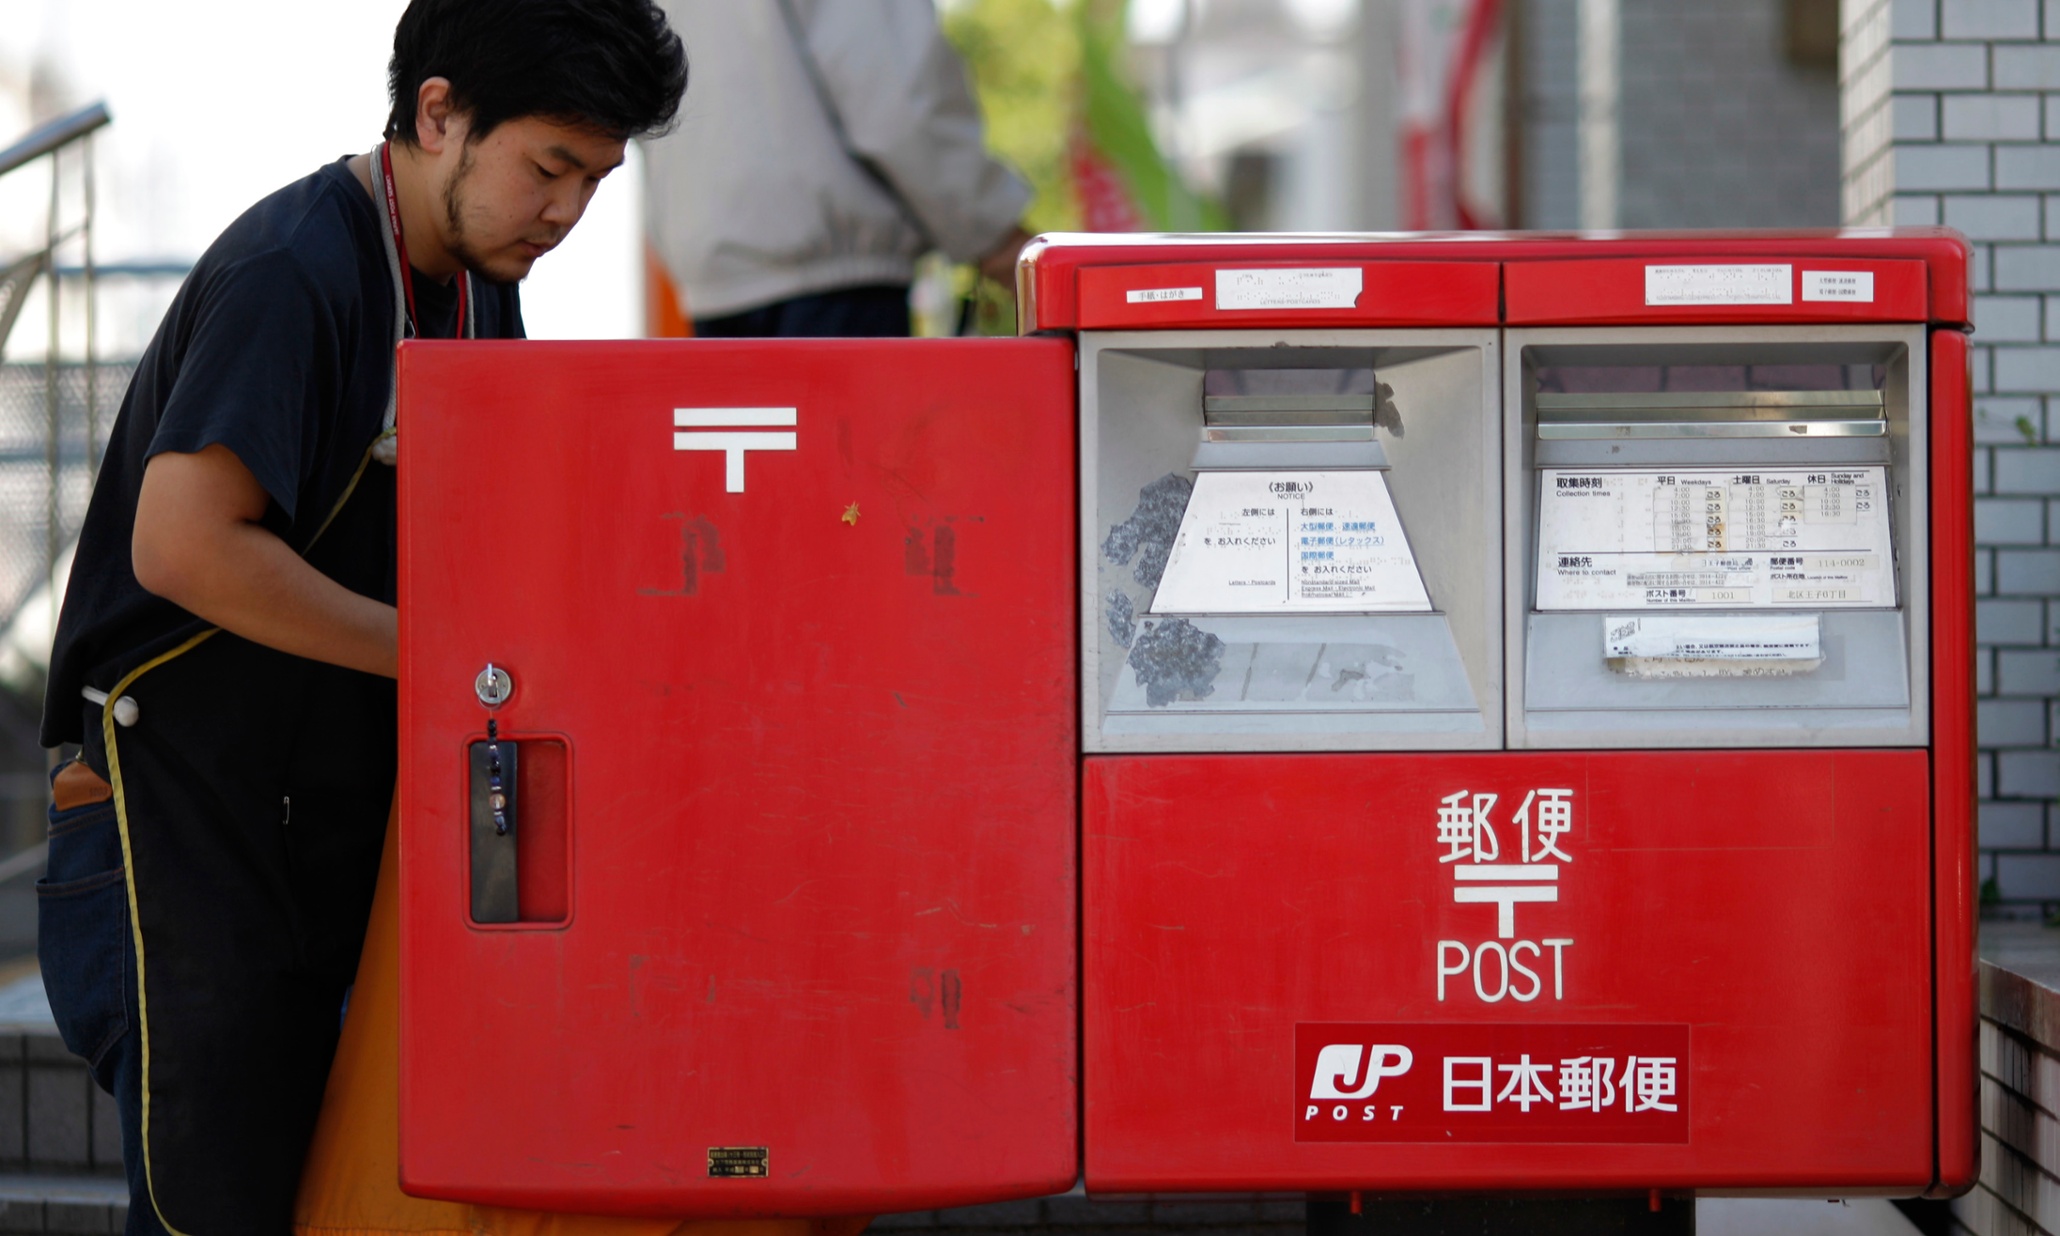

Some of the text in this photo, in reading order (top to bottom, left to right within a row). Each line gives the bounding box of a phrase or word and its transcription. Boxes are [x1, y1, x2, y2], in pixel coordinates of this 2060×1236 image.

[1138, 290, 1185, 300] 手紙・はがき
[1556, 477, 1602, 488] 取集時刻
[1657, 475, 1712, 486] 平日 Weekdays
[1733, 475, 1760, 485] 土曜日
[1807, 474, 1826, 484] 休日
[1242, 507, 1275, 517] 左側には
[1300, 507, 1333, 516] 右側には
[1301, 551, 1335, 560] 国際郵便
[1558, 556, 1592, 568] 連絡先
[1770, 557, 1865, 568] 郵便番号 114-0002
[1558, 568, 1579, 576] Where
[1591, 568, 1616, 576] contact
[1646, 589, 1735, 600] ポスト番号 1001
[1437, 788, 1574, 863] 郵便
[1437, 938, 1574, 1003] POST
[1309, 1044, 1413, 1099] JP
[1442, 1054, 1678, 1113] 日本郵便
[1305, 1104, 1404, 1121] POST
